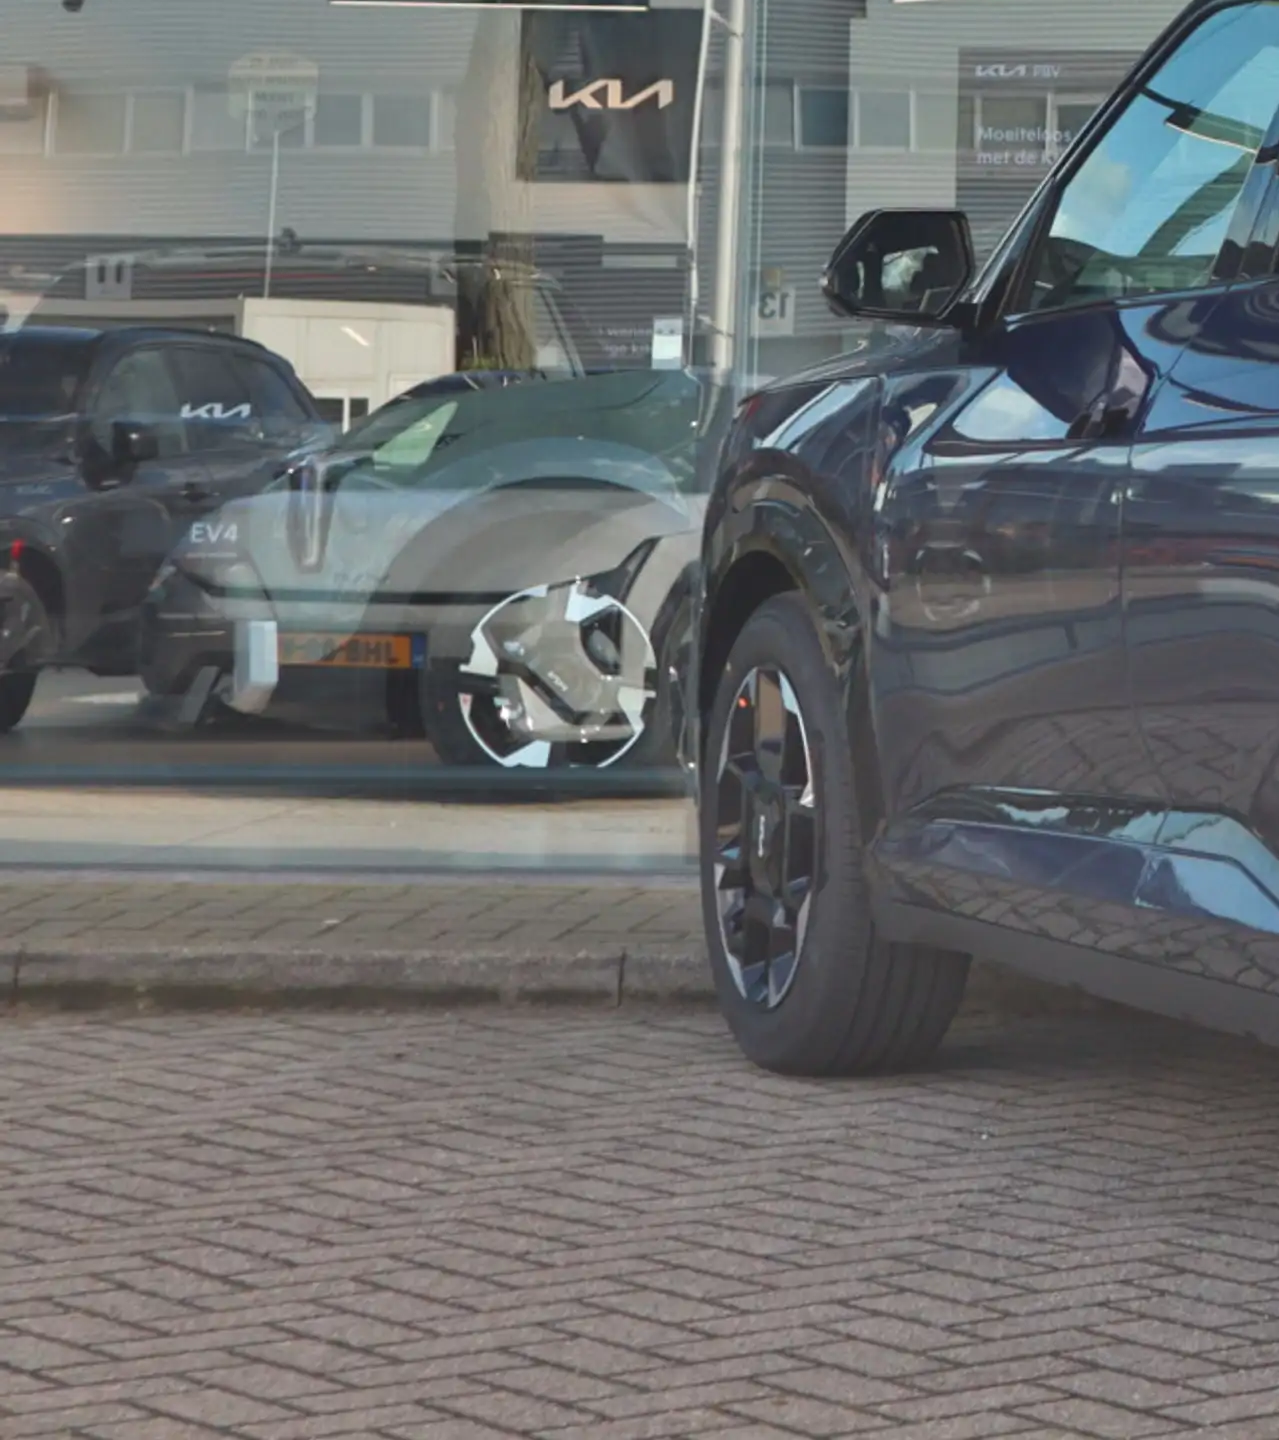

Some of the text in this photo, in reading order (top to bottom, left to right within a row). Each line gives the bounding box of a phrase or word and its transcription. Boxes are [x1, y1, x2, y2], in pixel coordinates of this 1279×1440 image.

[974, 64, 1026, 77] KIA
[548, 79, 673, 109] KIA
[180, 402, 251, 419] KIA
[191, 523, 238, 543] EV4
